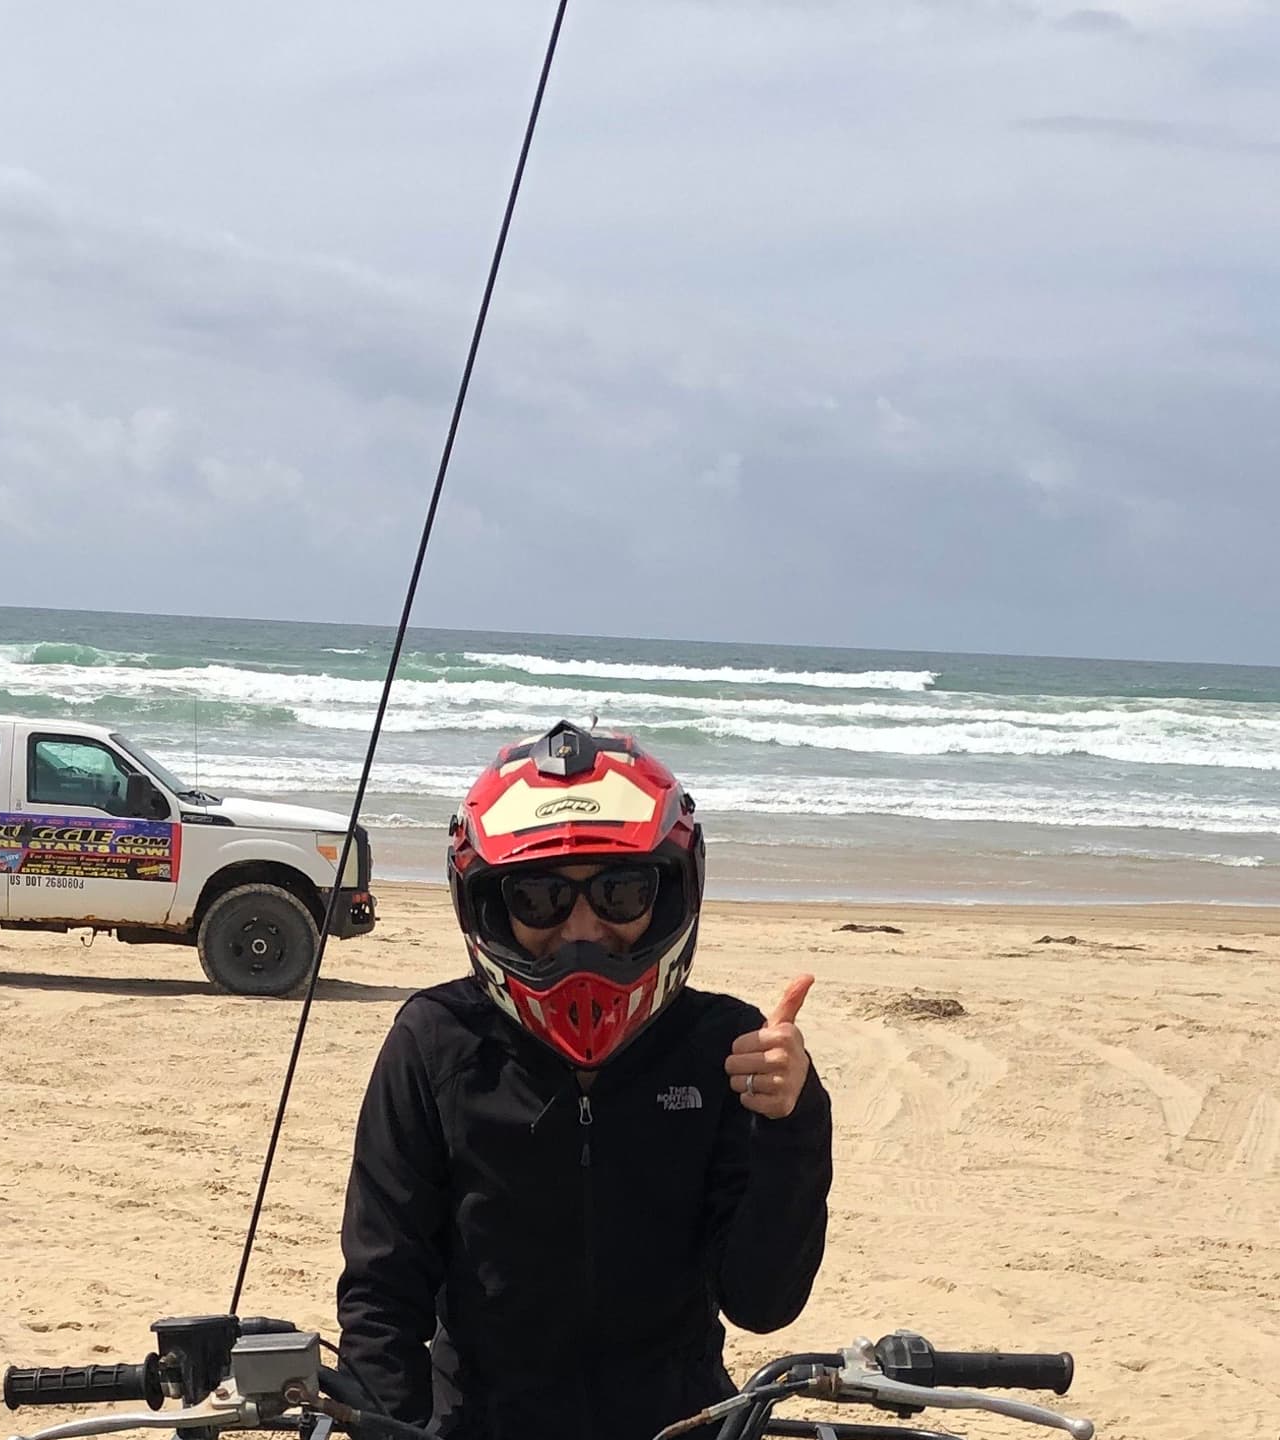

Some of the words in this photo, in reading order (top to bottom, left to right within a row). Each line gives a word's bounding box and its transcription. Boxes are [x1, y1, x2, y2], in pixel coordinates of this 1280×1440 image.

[28, 840, 111, 854] STARTS
[116, 846, 170, 857] NOW!
[9, 875, 21, 886] US
[25, 875, 42, 887] DOT
[669, 1086, 688, 1095] THE
[656, 1094, 689, 1103] NORTH
[663, 1102, 686, 1110] FACE
